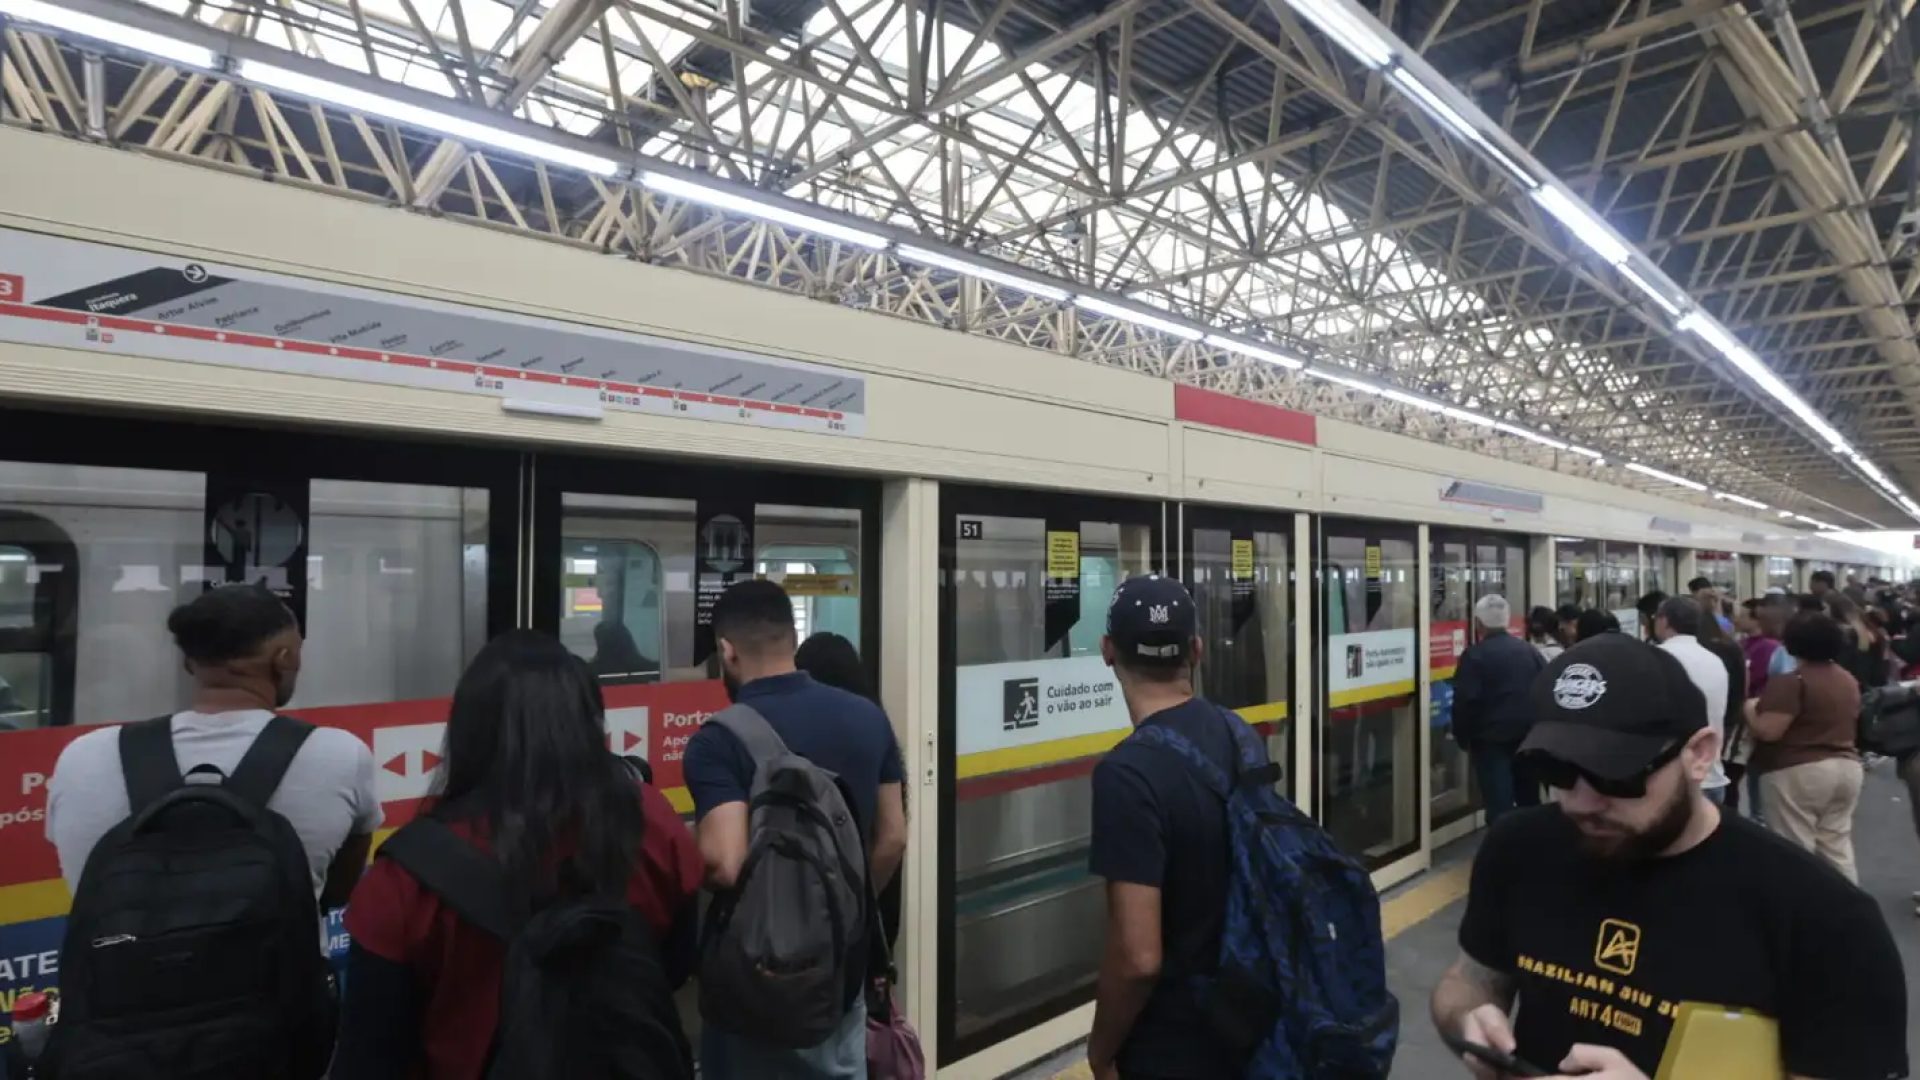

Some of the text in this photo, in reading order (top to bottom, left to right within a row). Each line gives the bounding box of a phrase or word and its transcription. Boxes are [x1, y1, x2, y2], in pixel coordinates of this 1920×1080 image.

[0, 280, 13, 296] 3
[963, 523, 979, 538] 51
[1047, 682, 1114, 699] Cuidado com
[1047, 695, 1113, 714] o vão ao sair
[663, 734, 691, 748] Apó
